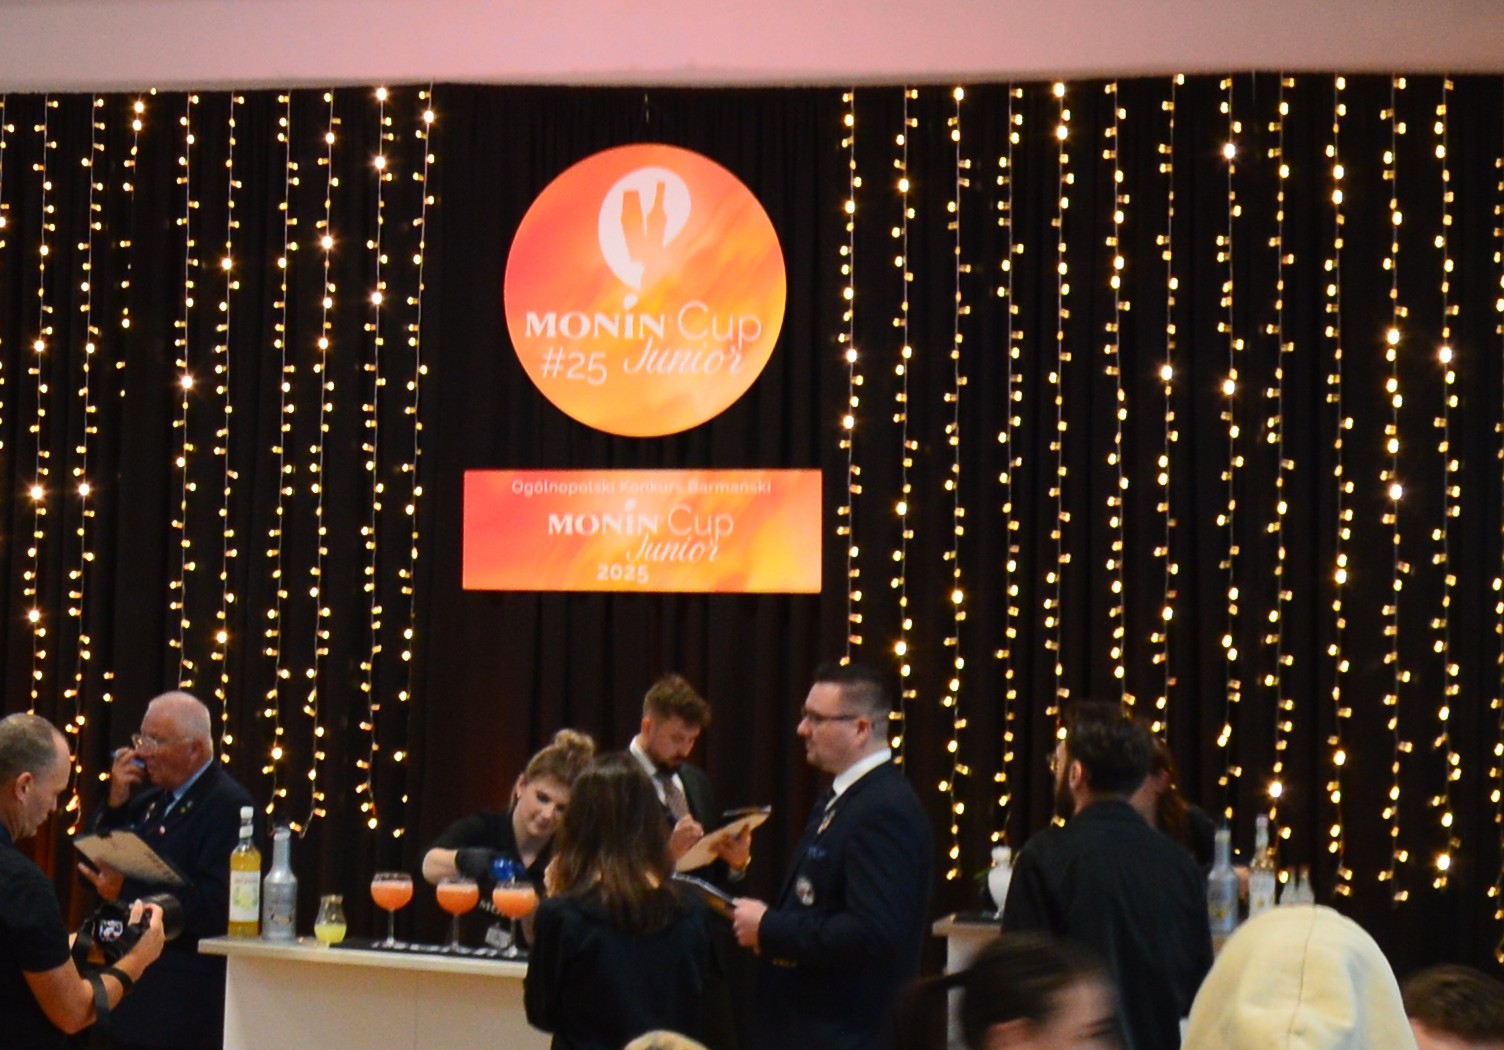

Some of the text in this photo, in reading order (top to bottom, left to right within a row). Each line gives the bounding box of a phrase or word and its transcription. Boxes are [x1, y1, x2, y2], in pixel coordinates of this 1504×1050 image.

[524, 293, 763, 350] MONIN Cup
[540, 334, 747, 386] #25 Junior
[547, 500, 735, 541] MONIN Cup
[624, 531, 721, 563] Junior
[596, 563, 650, 584] 2025
